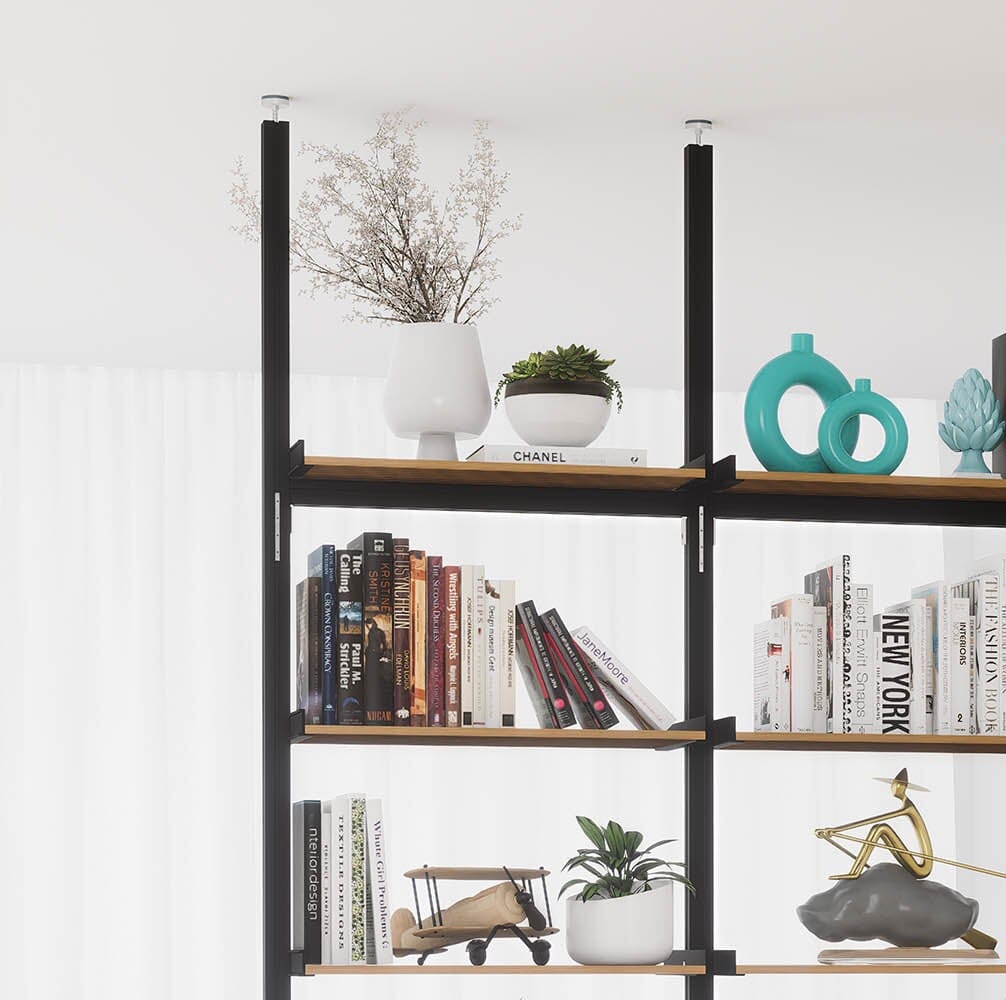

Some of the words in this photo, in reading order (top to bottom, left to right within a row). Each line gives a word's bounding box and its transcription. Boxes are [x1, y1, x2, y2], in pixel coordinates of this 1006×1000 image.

[513, 451, 566, 463] CHANEL
[338, 554, 352, 594] Calling
[352, 554, 362, 575] The
[432, 563, 442, 579] THE
[368, 570, 379, 603] SMITH
[381, 562, 391, 616] KRISTINE
[432, 580, 442, 609] SECOND
[447, 572, 460, 611] Wrestling
[985, 577, 999, 611] THE
[322, 592, 333, 625] CROWN
[447, 613, 460, 631] with
[487, 605, 497, 627] Design
[856, 587, 869, 623] Elliott
[432, 610, 442, 642] DUCHESS
[487, 628, 497, 655] museum
[882, 615, 910, 666] NEW
[960, 621, 968, 665] INTERIORS
[322, 626, 333, 673] CONSPIRACY
[351, 643, 362, 668] Paul
[447, 632, 460, 660] Angels
[577, 632, 630, 686] JaneMoore
[856, 629, 869, 667] Erwitt
[985, 614, 999, 683] FASHION
[339, 642, 351, 690] Strickler
[351, 670, 362, 685] M.
[854, 672, 868, 718] Snaps
[882, 672, 910, 734] YORK
[985, 688, 999, 733] BOOK
